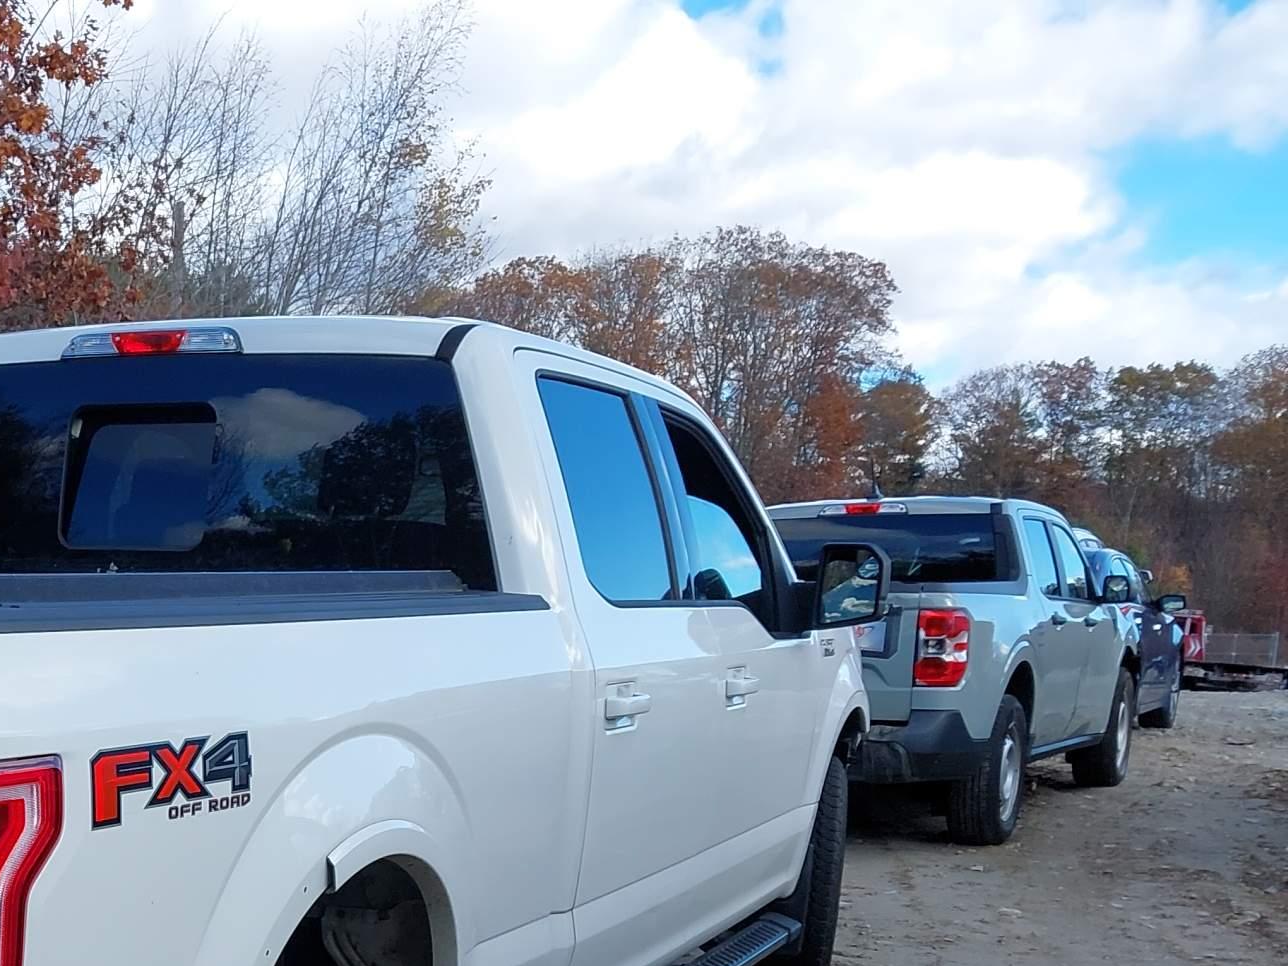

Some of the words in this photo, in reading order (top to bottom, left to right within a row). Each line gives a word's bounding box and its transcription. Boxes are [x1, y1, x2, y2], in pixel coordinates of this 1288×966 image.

[89, 730, 252, 831] FX4
[168, 802, 203, 820] OFF
[208, 792, 252, 813] ROAD
